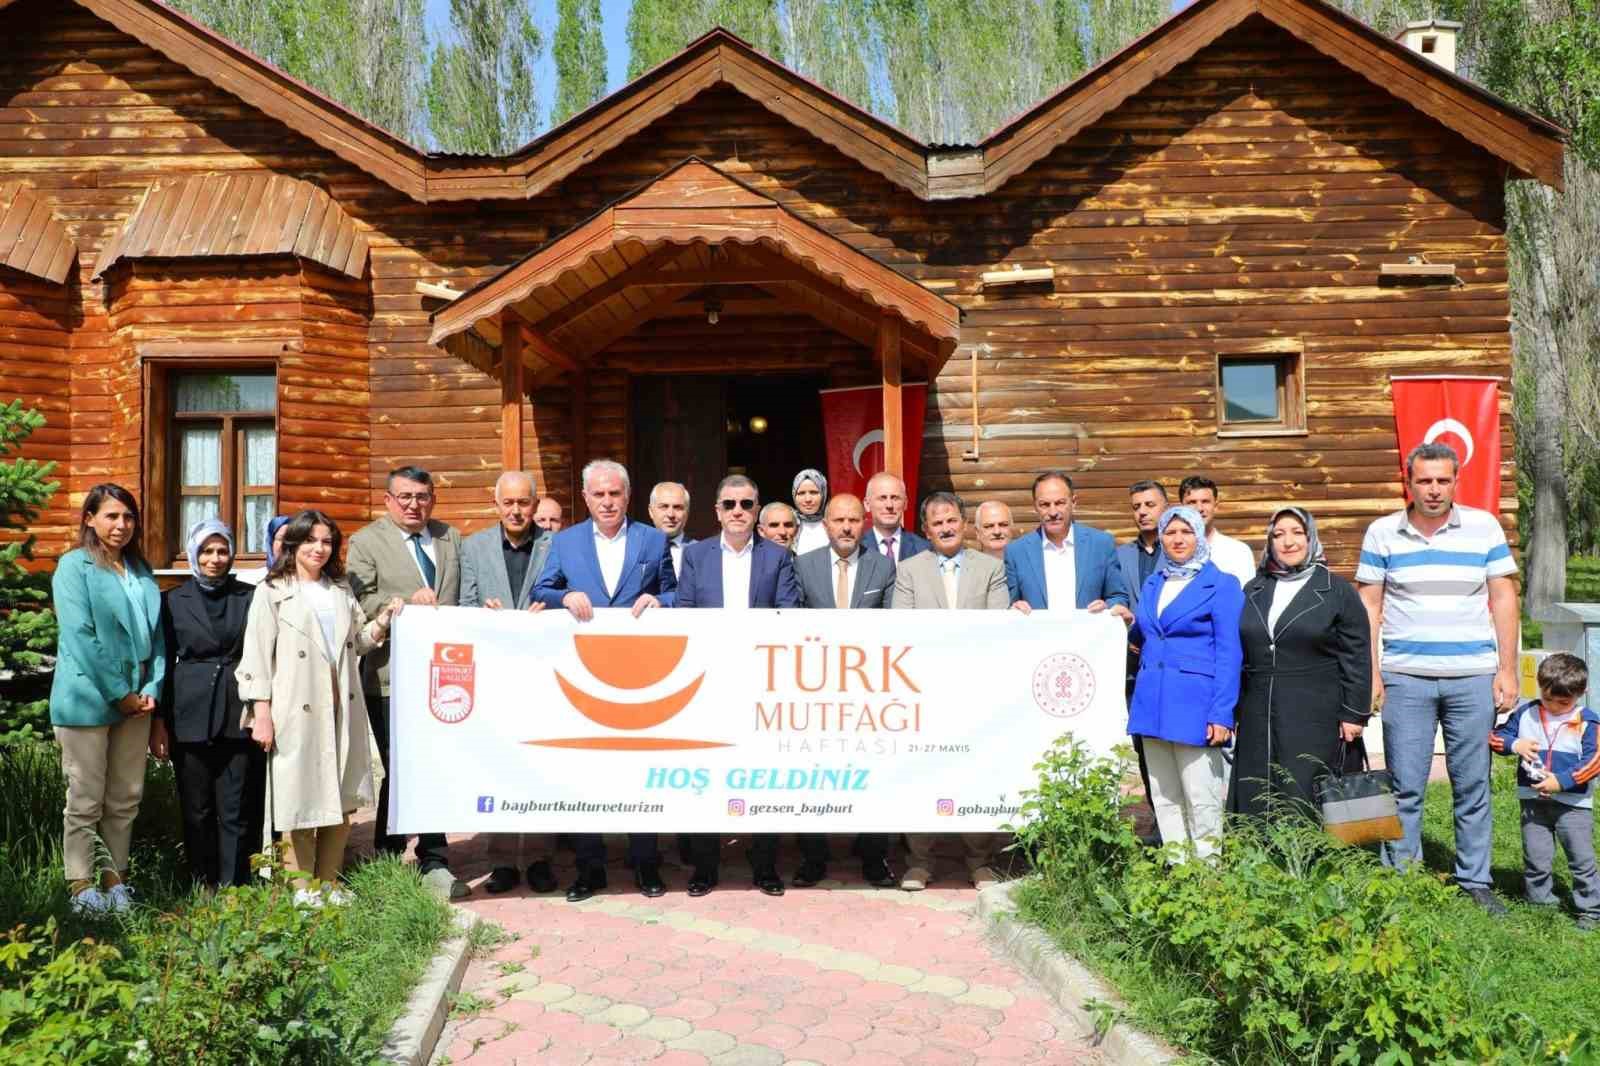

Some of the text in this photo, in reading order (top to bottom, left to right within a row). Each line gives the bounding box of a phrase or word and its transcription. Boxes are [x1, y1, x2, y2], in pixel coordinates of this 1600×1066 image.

[755, 636, 921, 693] TÜRK
[756, 698, 920, 732] MUTFAĞI
[908, 744, 971, 752] 21-27 MAYIS
[645, 764, 870, 794] HOŞ GELDİNİZ
[500, 800, 664, 815] bayburtkulturveturizm
[749, 803, 853, 816] gezsen_bayburt
